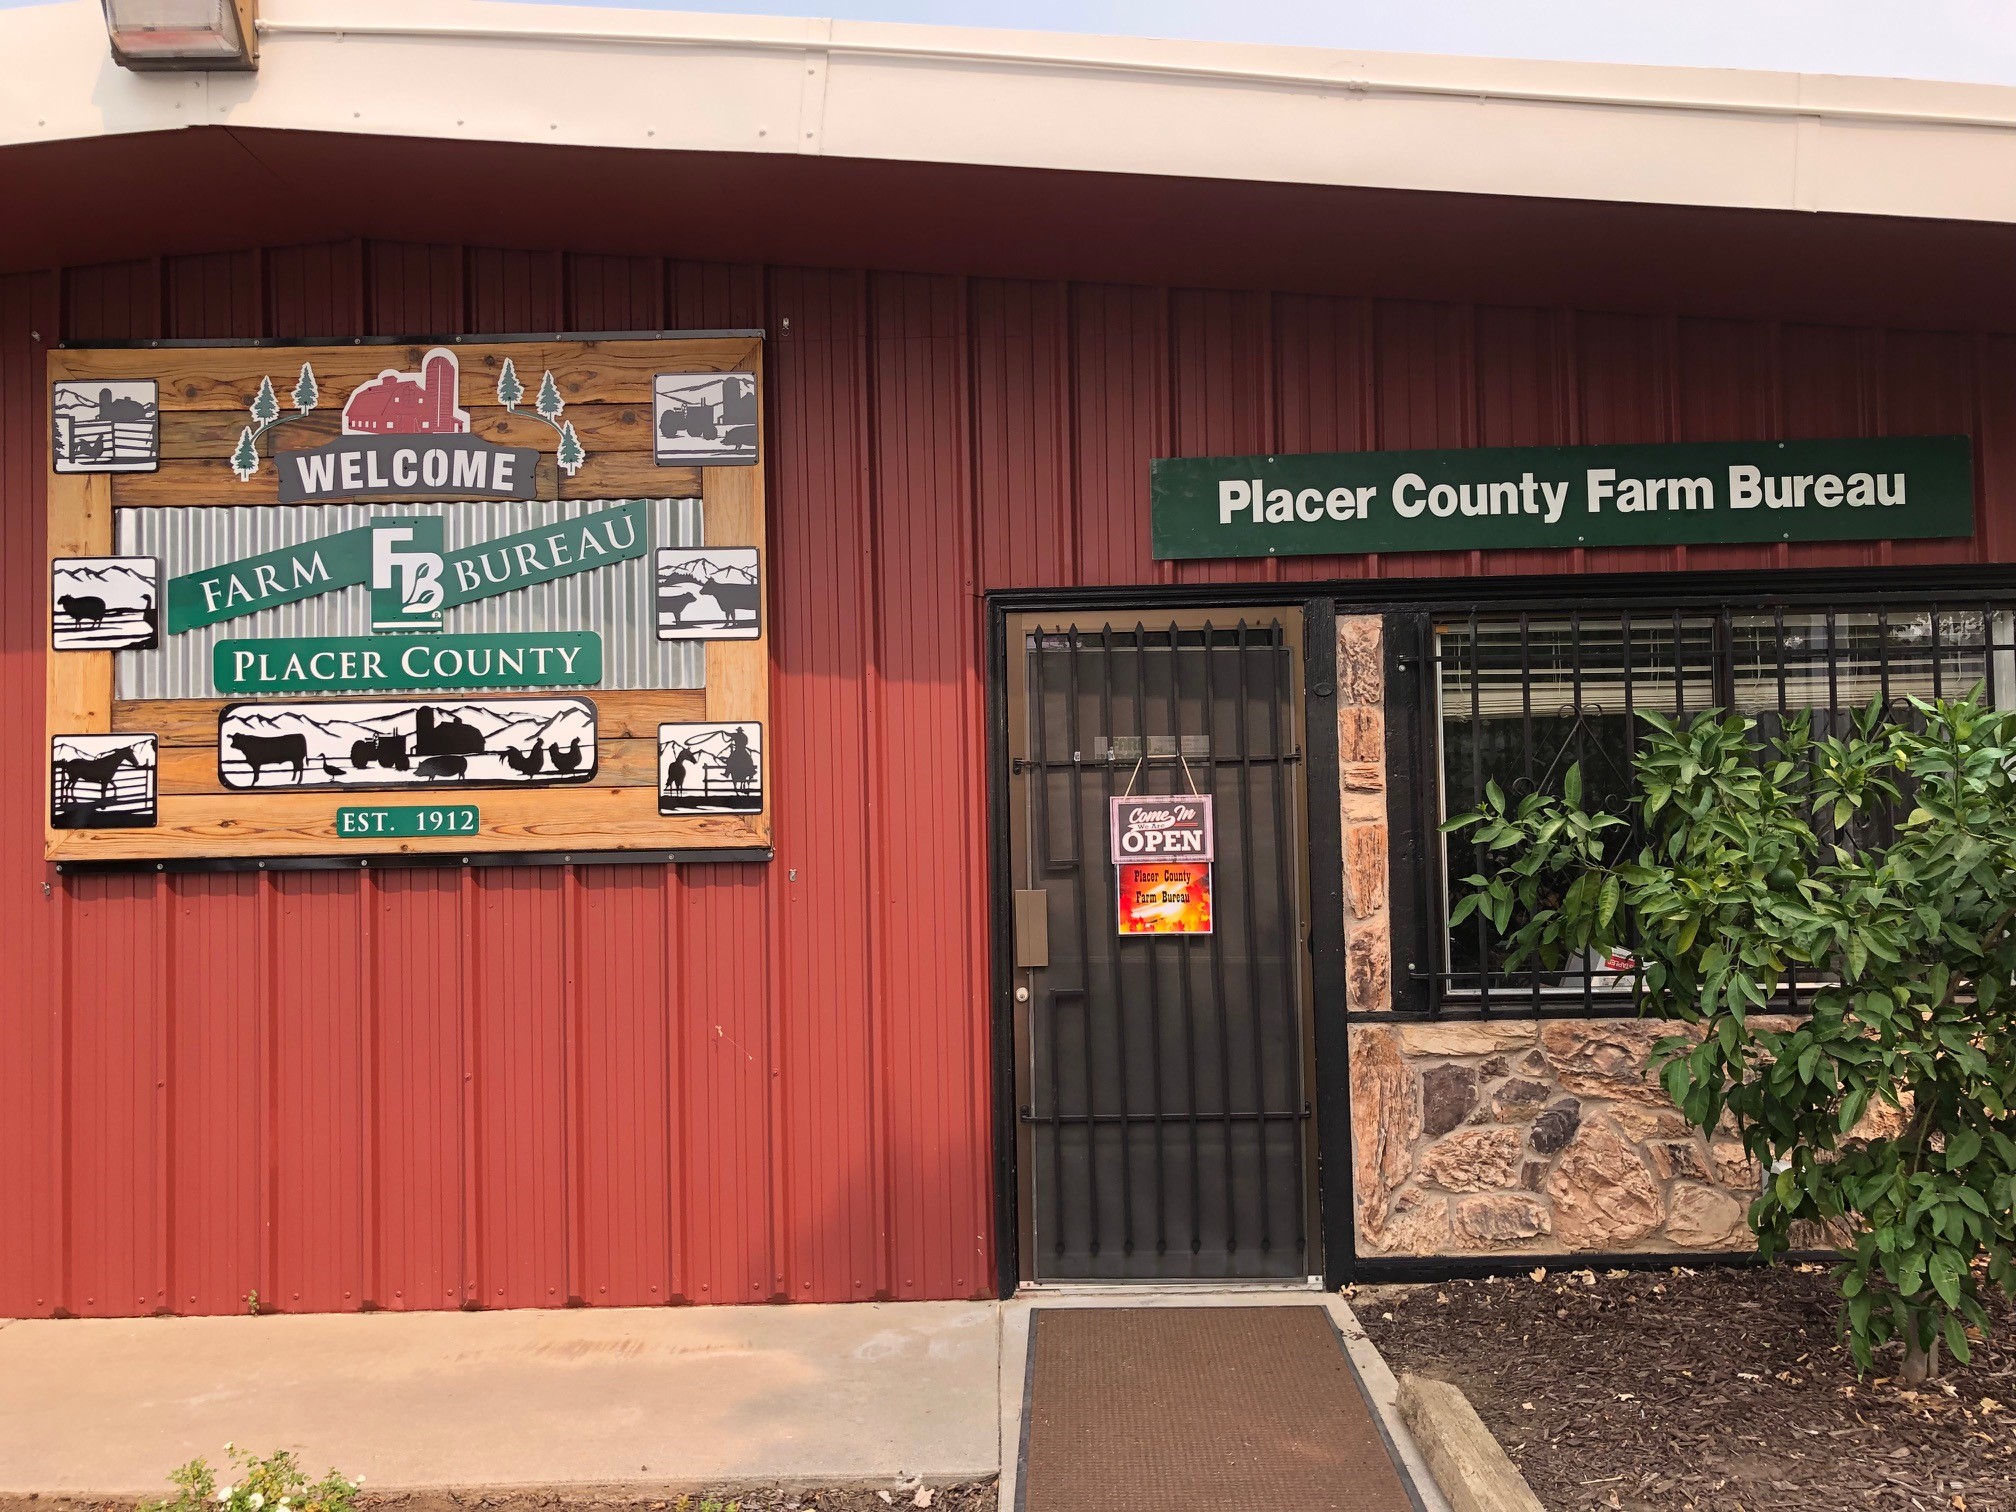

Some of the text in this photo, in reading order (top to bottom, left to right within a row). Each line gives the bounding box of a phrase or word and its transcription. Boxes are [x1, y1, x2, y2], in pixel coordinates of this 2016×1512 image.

[295, 448, 516, 494] WELCOME
[1218, 465, 1906, 524] Placer County Farm Bureau
[199, 514, 637, 614] FARM BUREAU
[373, 528, 444, 613] FB
[232, 646, 581, 682] PLACER COUNTY
[343, 810, 474, 832] EST. 1912
[1129, 805, 1196, 823] Come In
[1122, 829, 1203, 853] OPEN
[1134, 869, 1191, 885] Placer County
[1136, 891, 1190, 904] Farm Bureau
